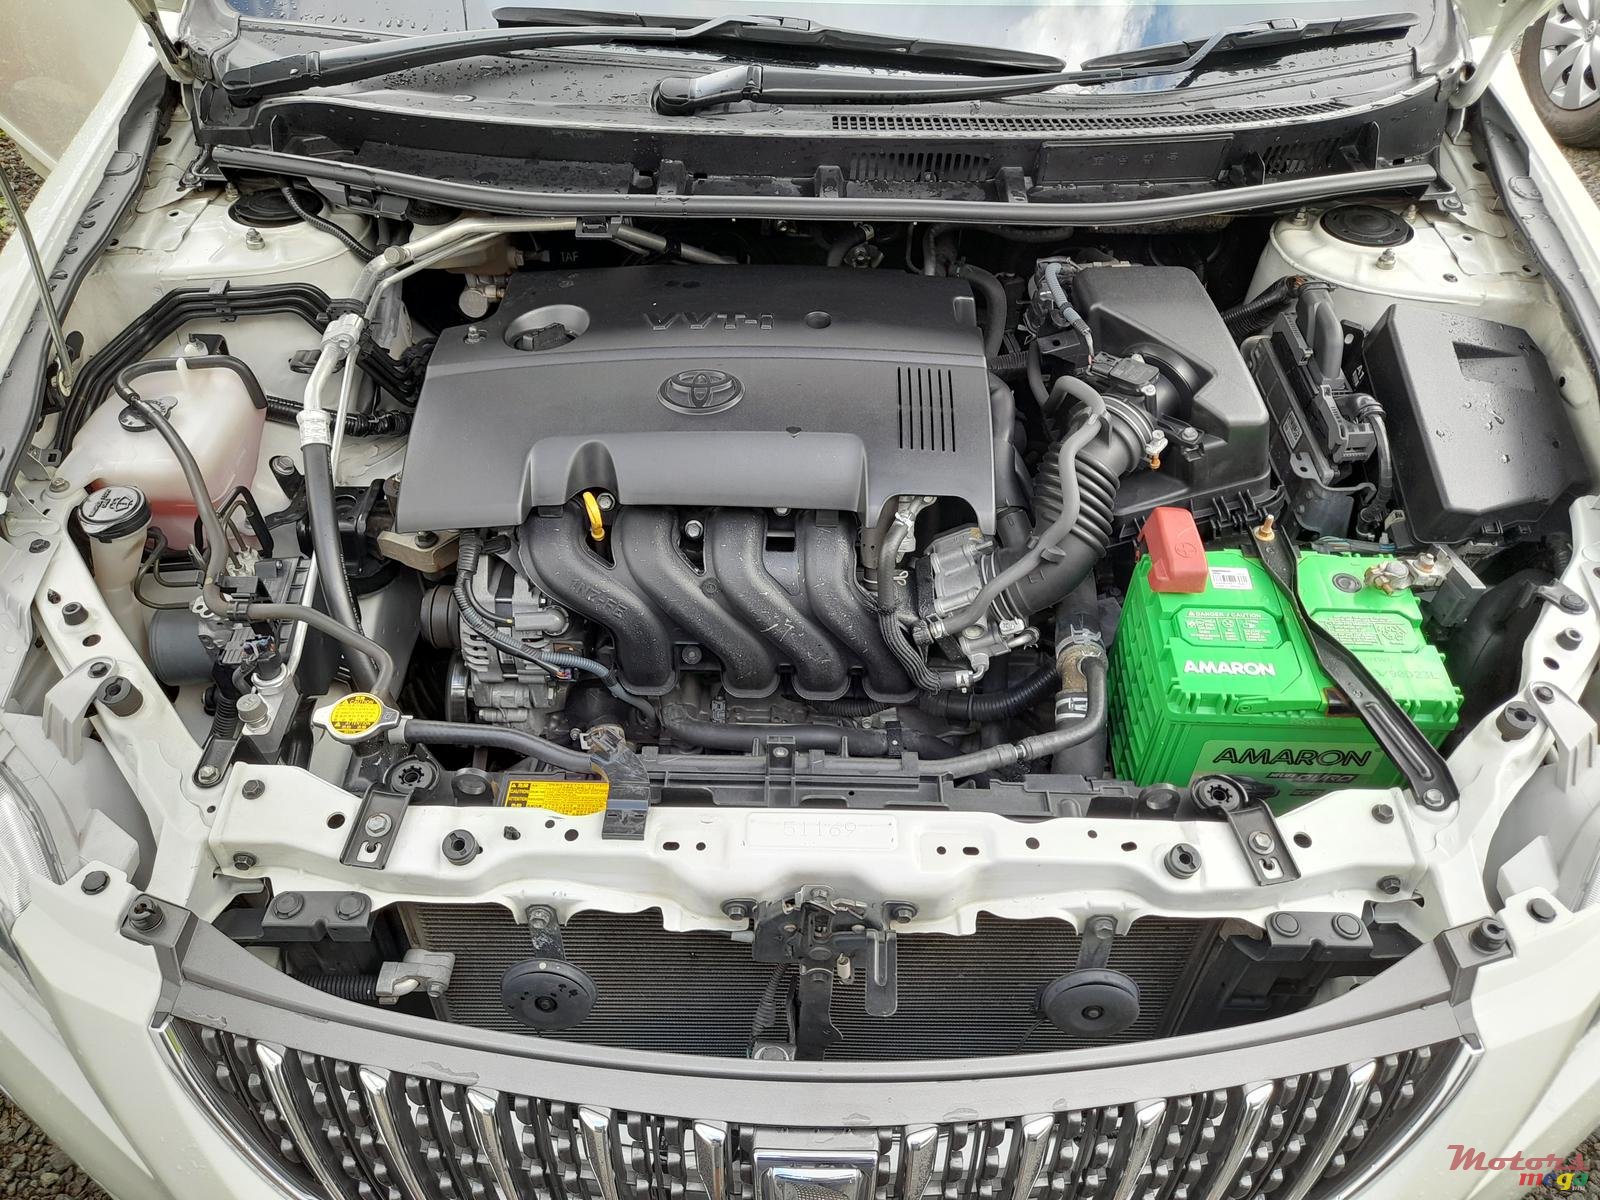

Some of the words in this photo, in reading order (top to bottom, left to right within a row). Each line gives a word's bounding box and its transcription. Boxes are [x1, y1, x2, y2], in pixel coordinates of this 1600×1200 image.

[1184, 660, 1276, 676] AMARON
[1213, 748, 1372, 767] AMARON
[783, 821, 857, 837] 51169
